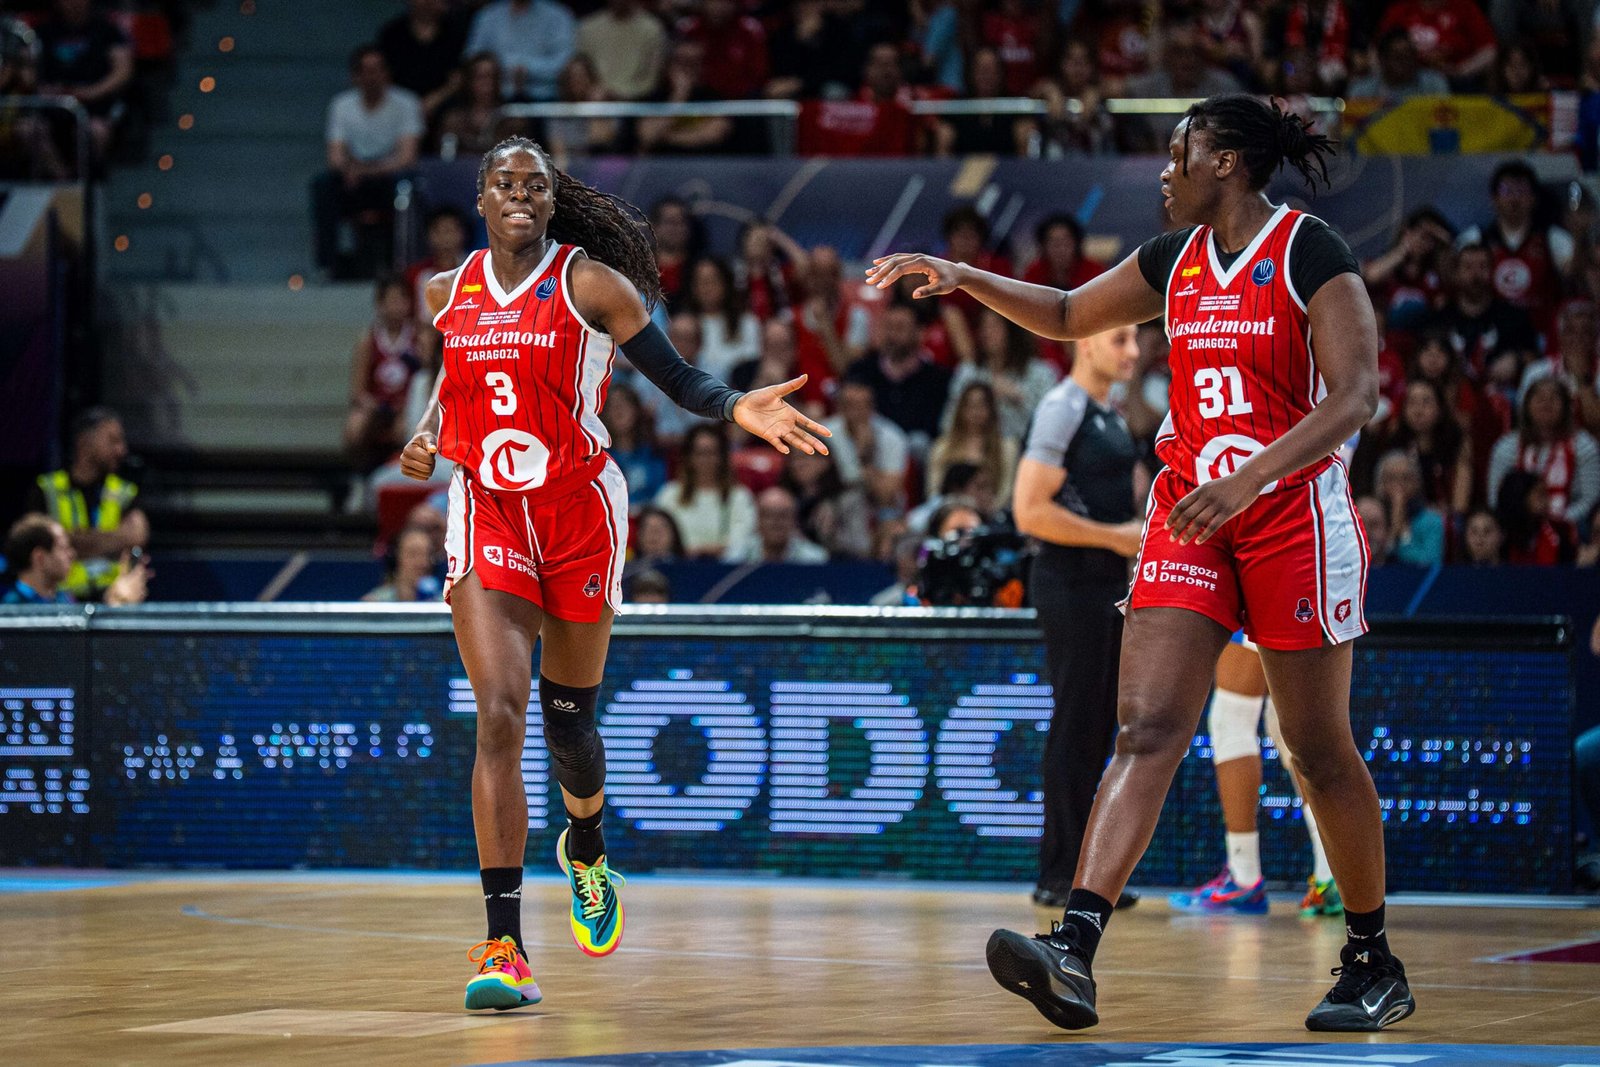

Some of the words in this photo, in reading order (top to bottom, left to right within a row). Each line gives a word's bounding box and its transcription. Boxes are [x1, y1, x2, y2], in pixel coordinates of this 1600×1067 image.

[1171, 315, 1276, 339] Casademont
[444, 328, 557, 348] Casademont
[1187, 338, 1238, 350] ZARAGOZA
[466, 349, 520, 362] ZARAGOZA
[485, 371, 518, 416] 3
[1194, 366, 1253, 419] 31
[1161, 560, 1218, 580] Zaragoza
[1159, 571, 1217, 592] DEPORTE
